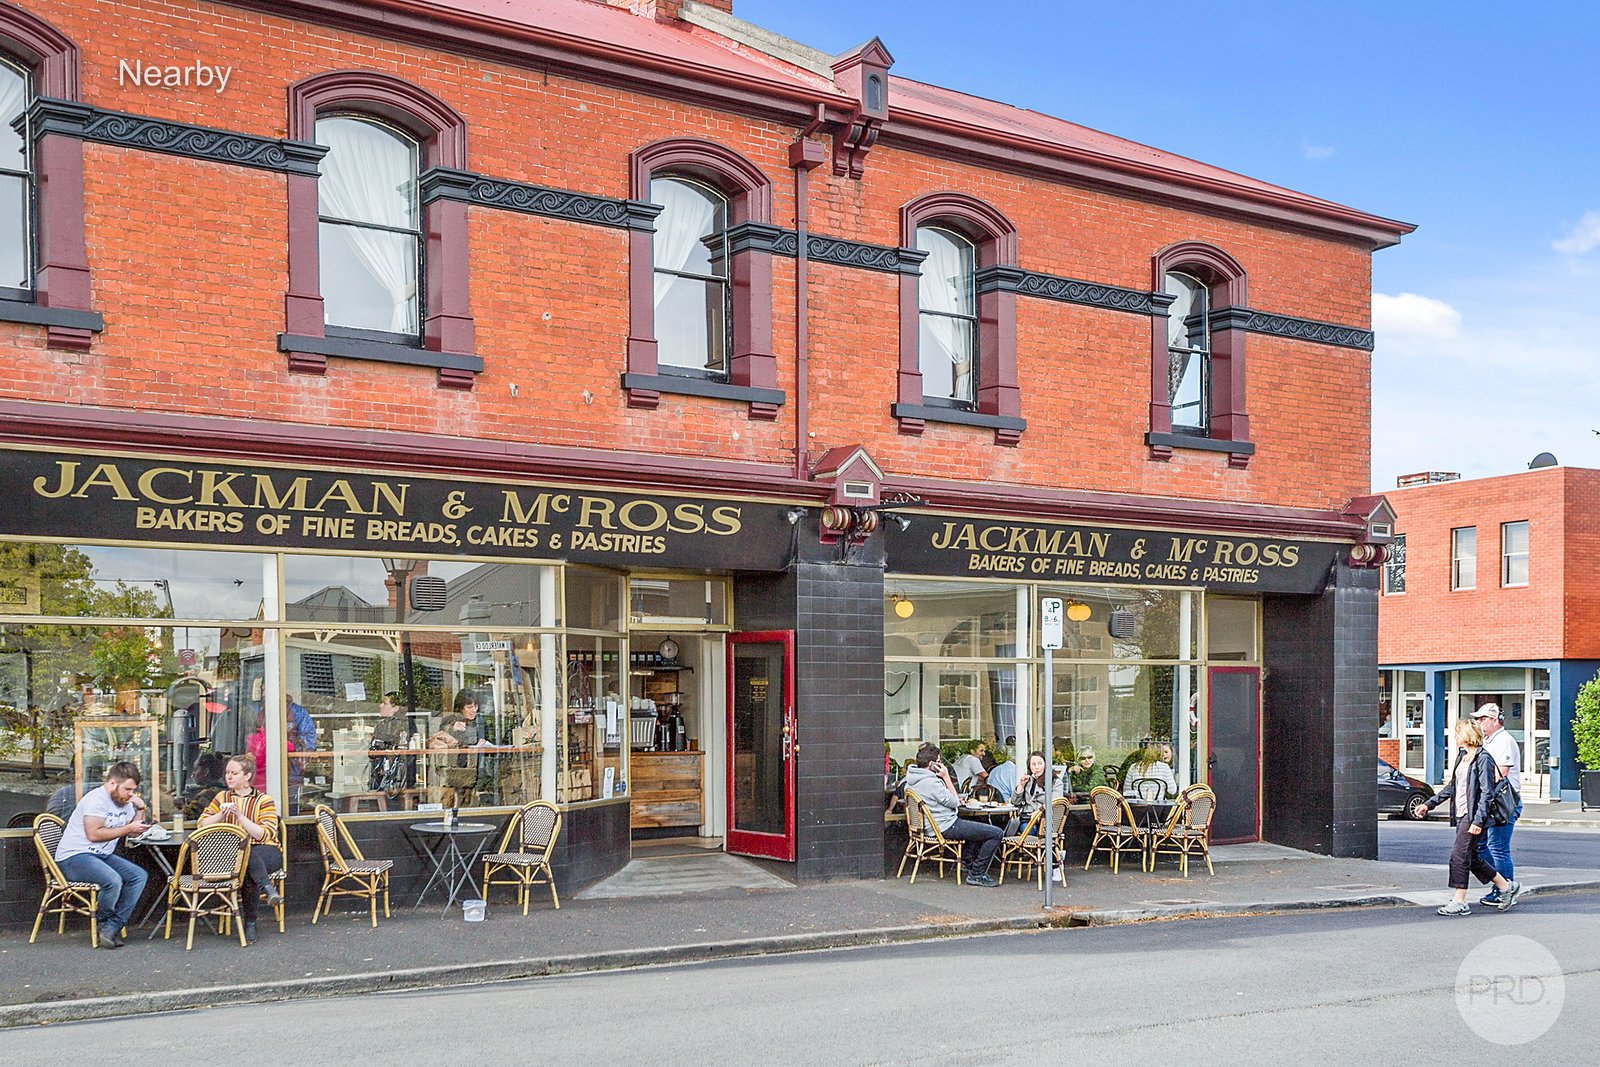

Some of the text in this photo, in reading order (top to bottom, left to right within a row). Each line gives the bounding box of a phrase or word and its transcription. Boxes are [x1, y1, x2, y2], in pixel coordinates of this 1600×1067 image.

[33, 461, 409, 517] JACKMAN
[442, 490, 473, 519] &
[136, 507, 666, 554] BAKERS OF FINE BREADS, CAKES & PASTRIES
[931, 522, 1110, 557] JACKMAN
[1130, 538, 1146, 560] &
[968, 554, 1259, 584] BAKERS OF FINE BREADS, CAKES & PASTRIES
